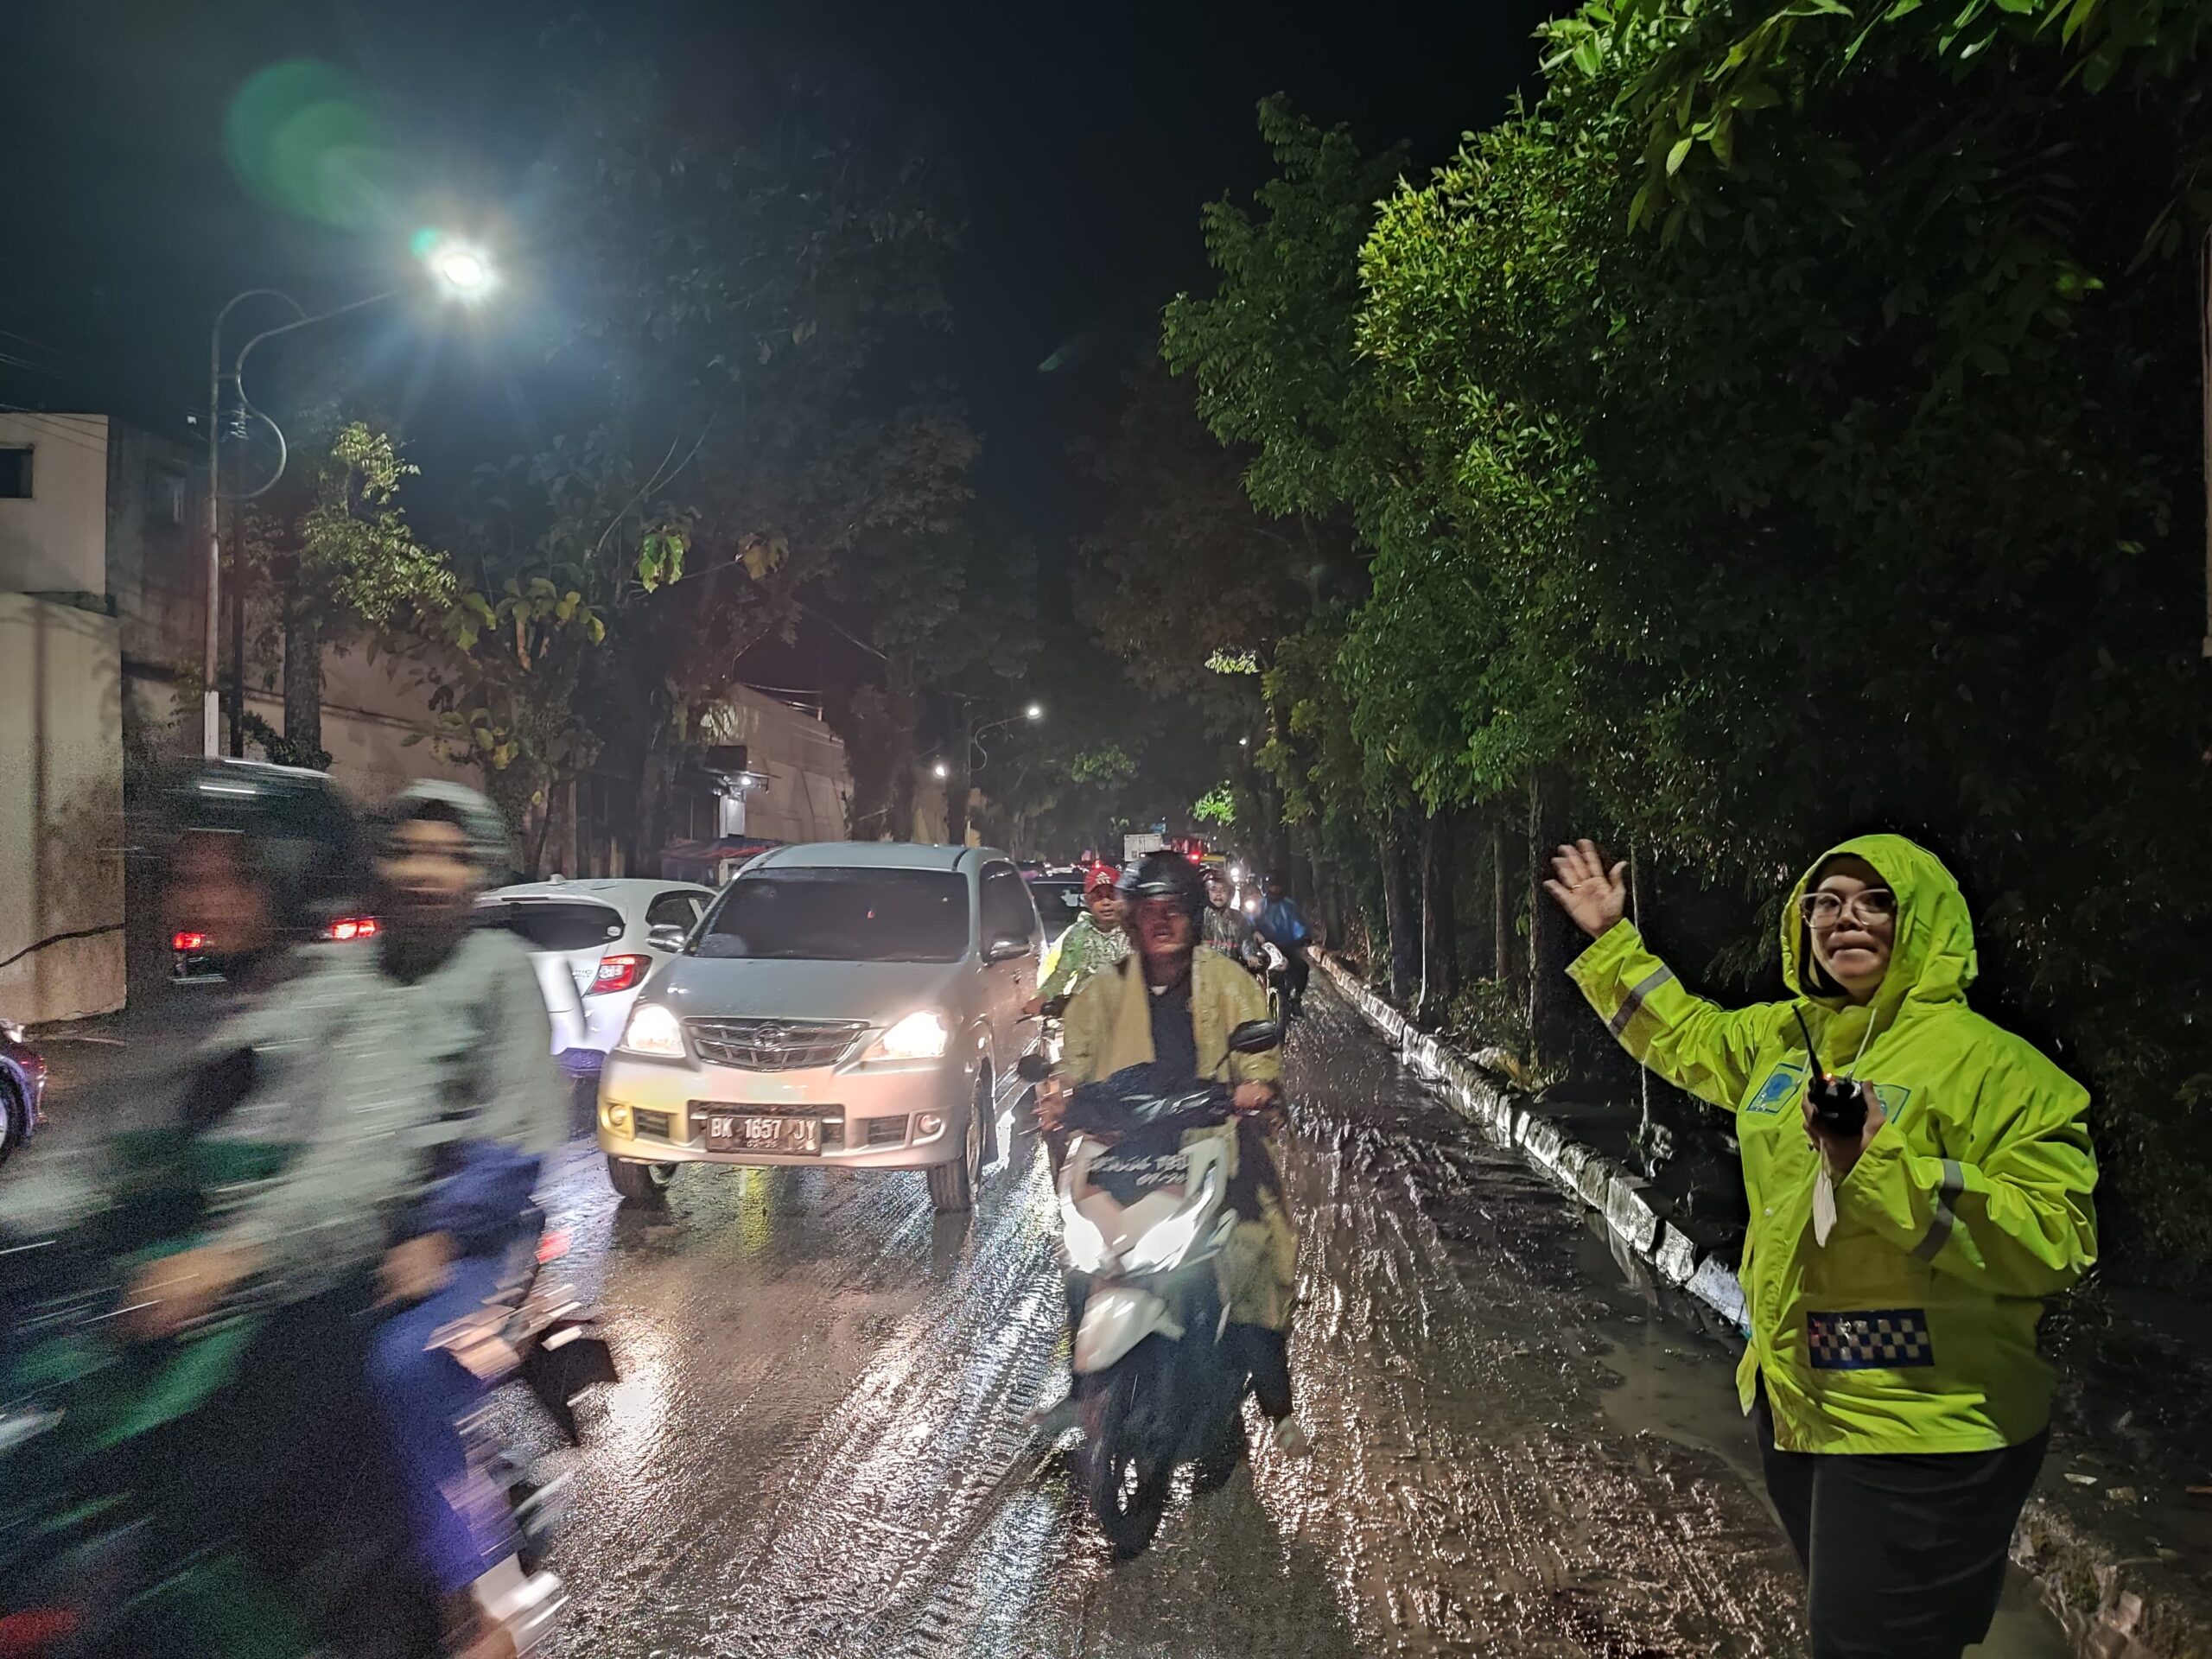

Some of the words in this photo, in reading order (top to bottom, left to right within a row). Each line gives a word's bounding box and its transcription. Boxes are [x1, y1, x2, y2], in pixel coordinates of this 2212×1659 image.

[711, 1117, 734, 1138] BK
[744, 1117, 782, 1139] 1657
[793, 1120, 817, 1140] JY
